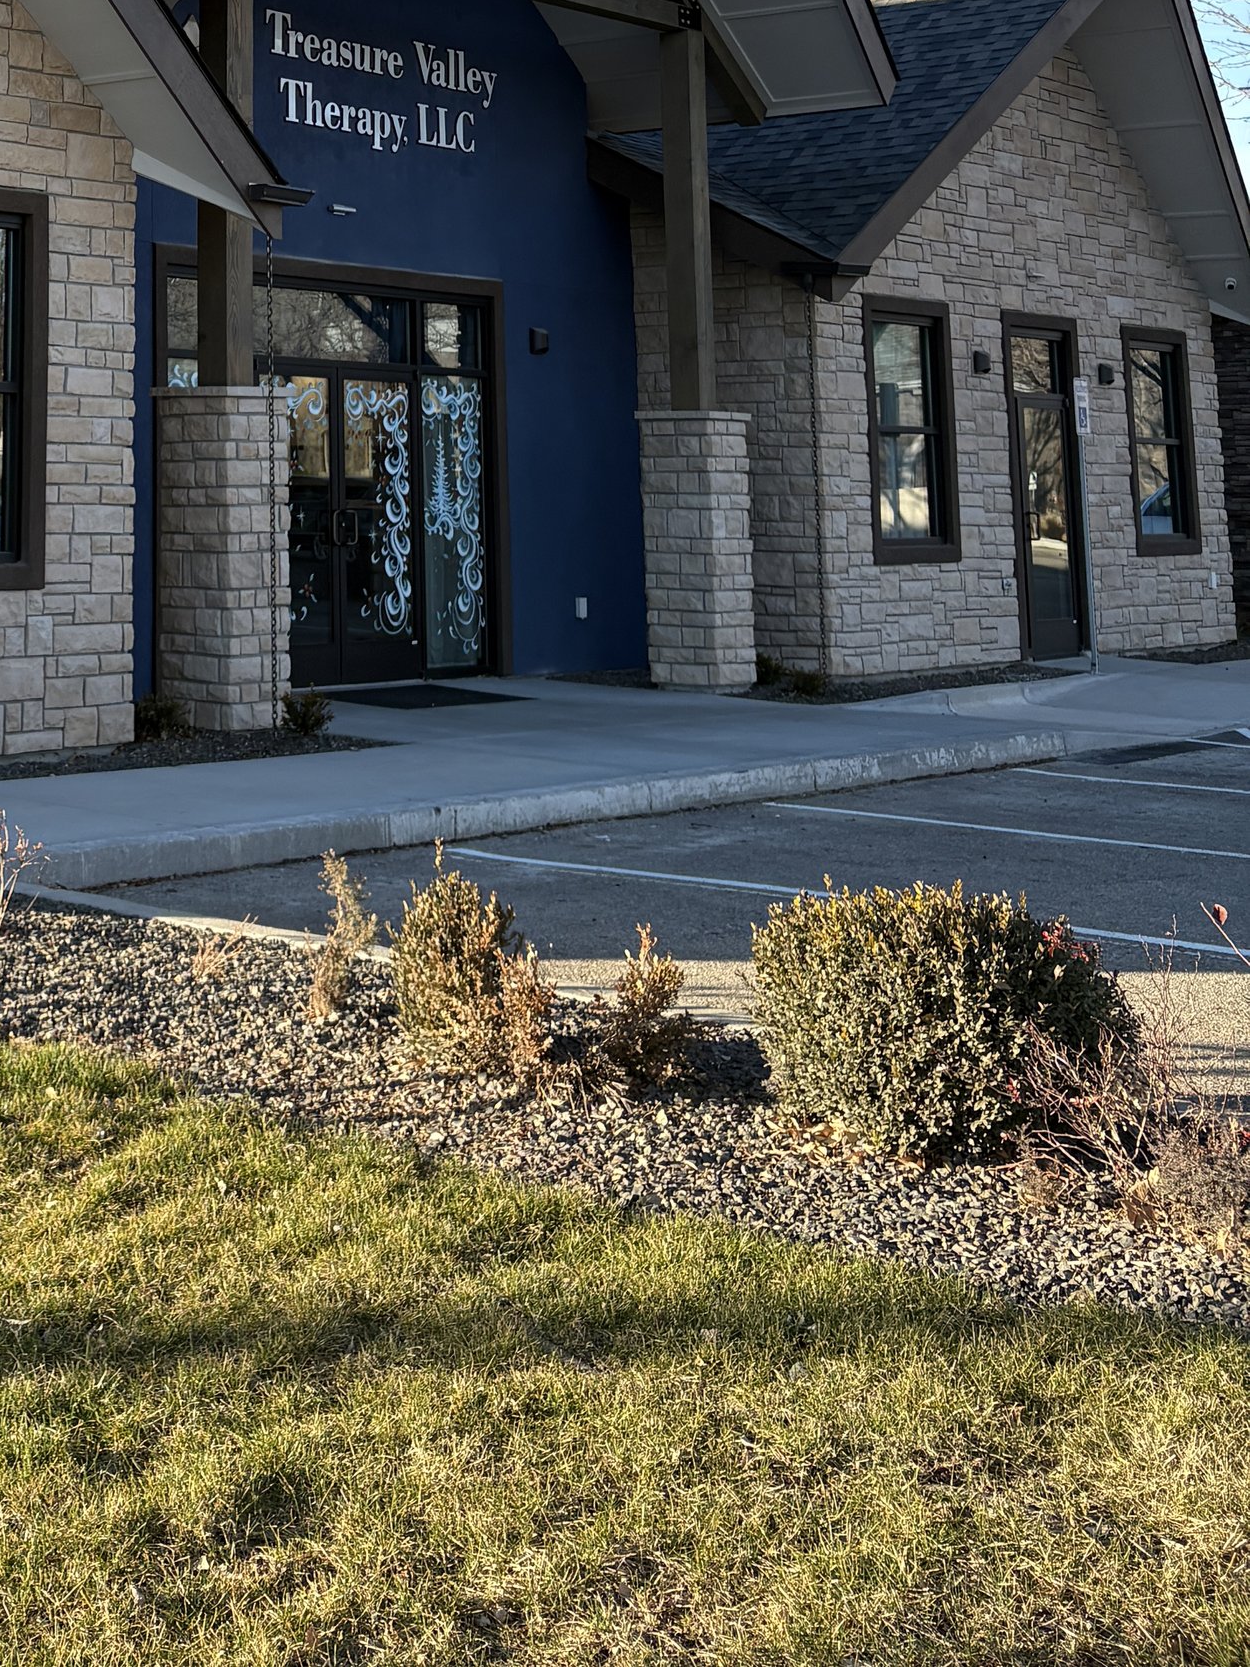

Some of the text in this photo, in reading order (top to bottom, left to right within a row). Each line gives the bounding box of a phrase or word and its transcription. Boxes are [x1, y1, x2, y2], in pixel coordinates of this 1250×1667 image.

[265, 9, 498, 109] Treasure Valley
[279, 77, 475, 153] Therapy, LLC
